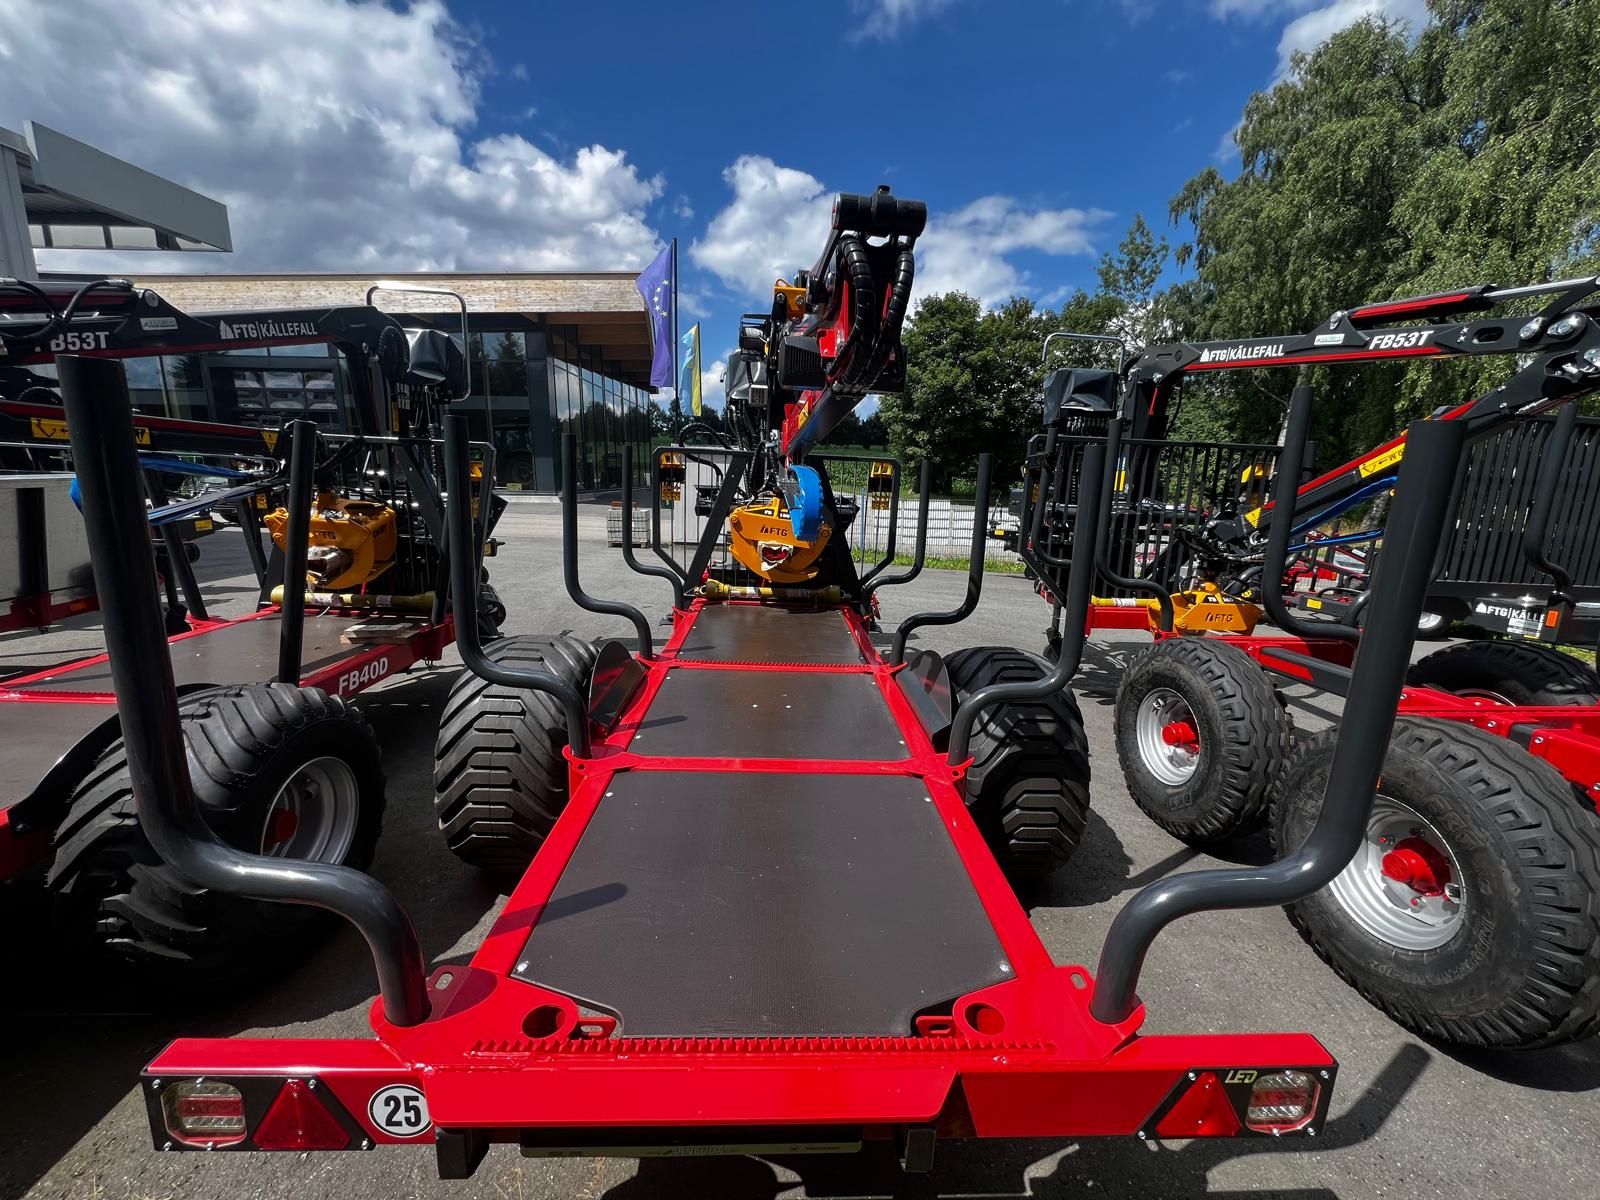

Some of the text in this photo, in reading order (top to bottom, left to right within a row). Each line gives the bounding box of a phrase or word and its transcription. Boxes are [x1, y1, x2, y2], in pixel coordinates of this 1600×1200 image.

[35, 331, 110, 352] B53T
[1368, 330, 1435, 350] FB53T
[1209, 343, 1285, 362] FTG KÄLLEFALL
[769, 527, 788, 537] FTG
[1214, 613, 1233, 622] FTG
[1486, 605, 1509, 617] FTG
[338, 657, 389, 696] FB40D
[1224, 1069, 1258, 1084] LED
[383, 1094, 422, 1128] 25
